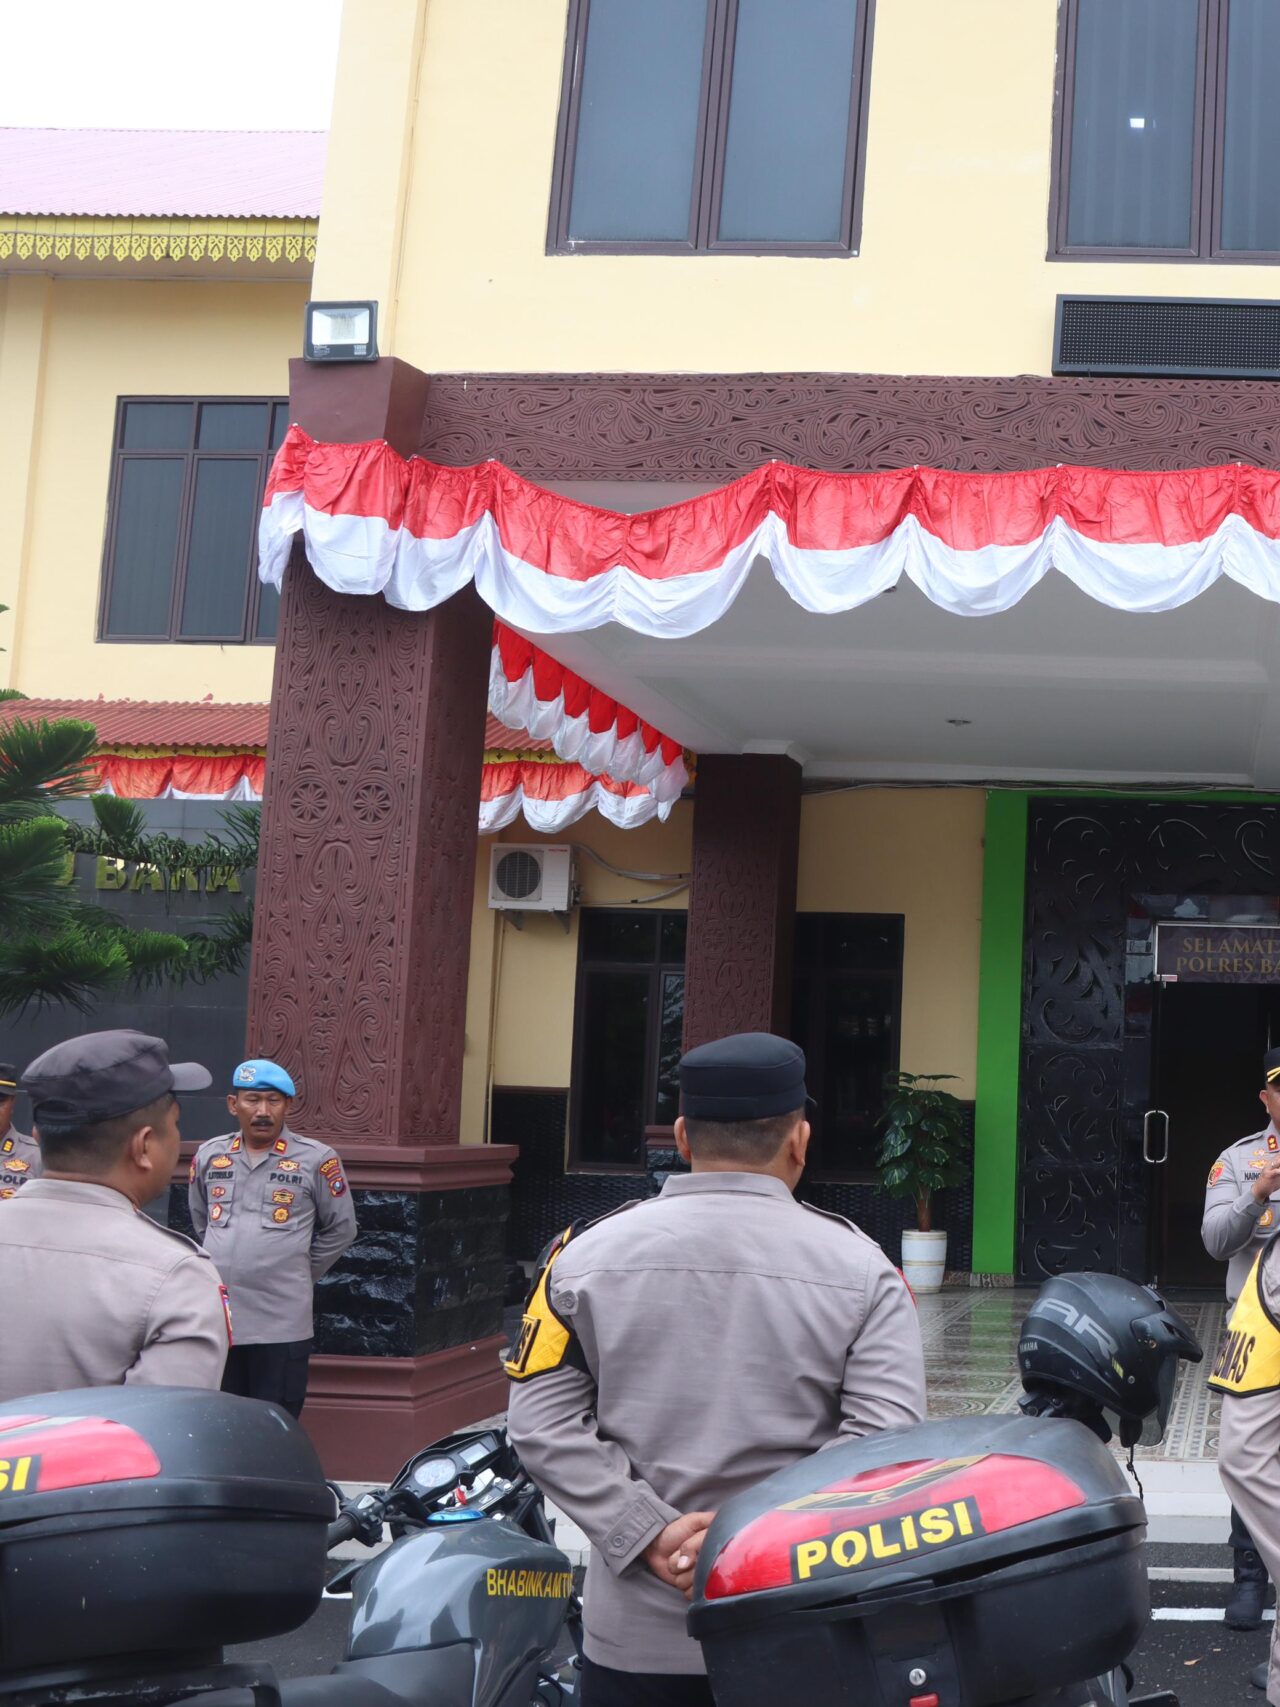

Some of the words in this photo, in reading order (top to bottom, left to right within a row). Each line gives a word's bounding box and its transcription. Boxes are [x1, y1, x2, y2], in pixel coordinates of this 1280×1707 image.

[1183, 937, 1275, 955] SELAMAT
[1176, 956, 1257, 974] POLRES
[269, 1172, 303, 1185] POLRI
[796, 1501, 974, 1580] POLISI
